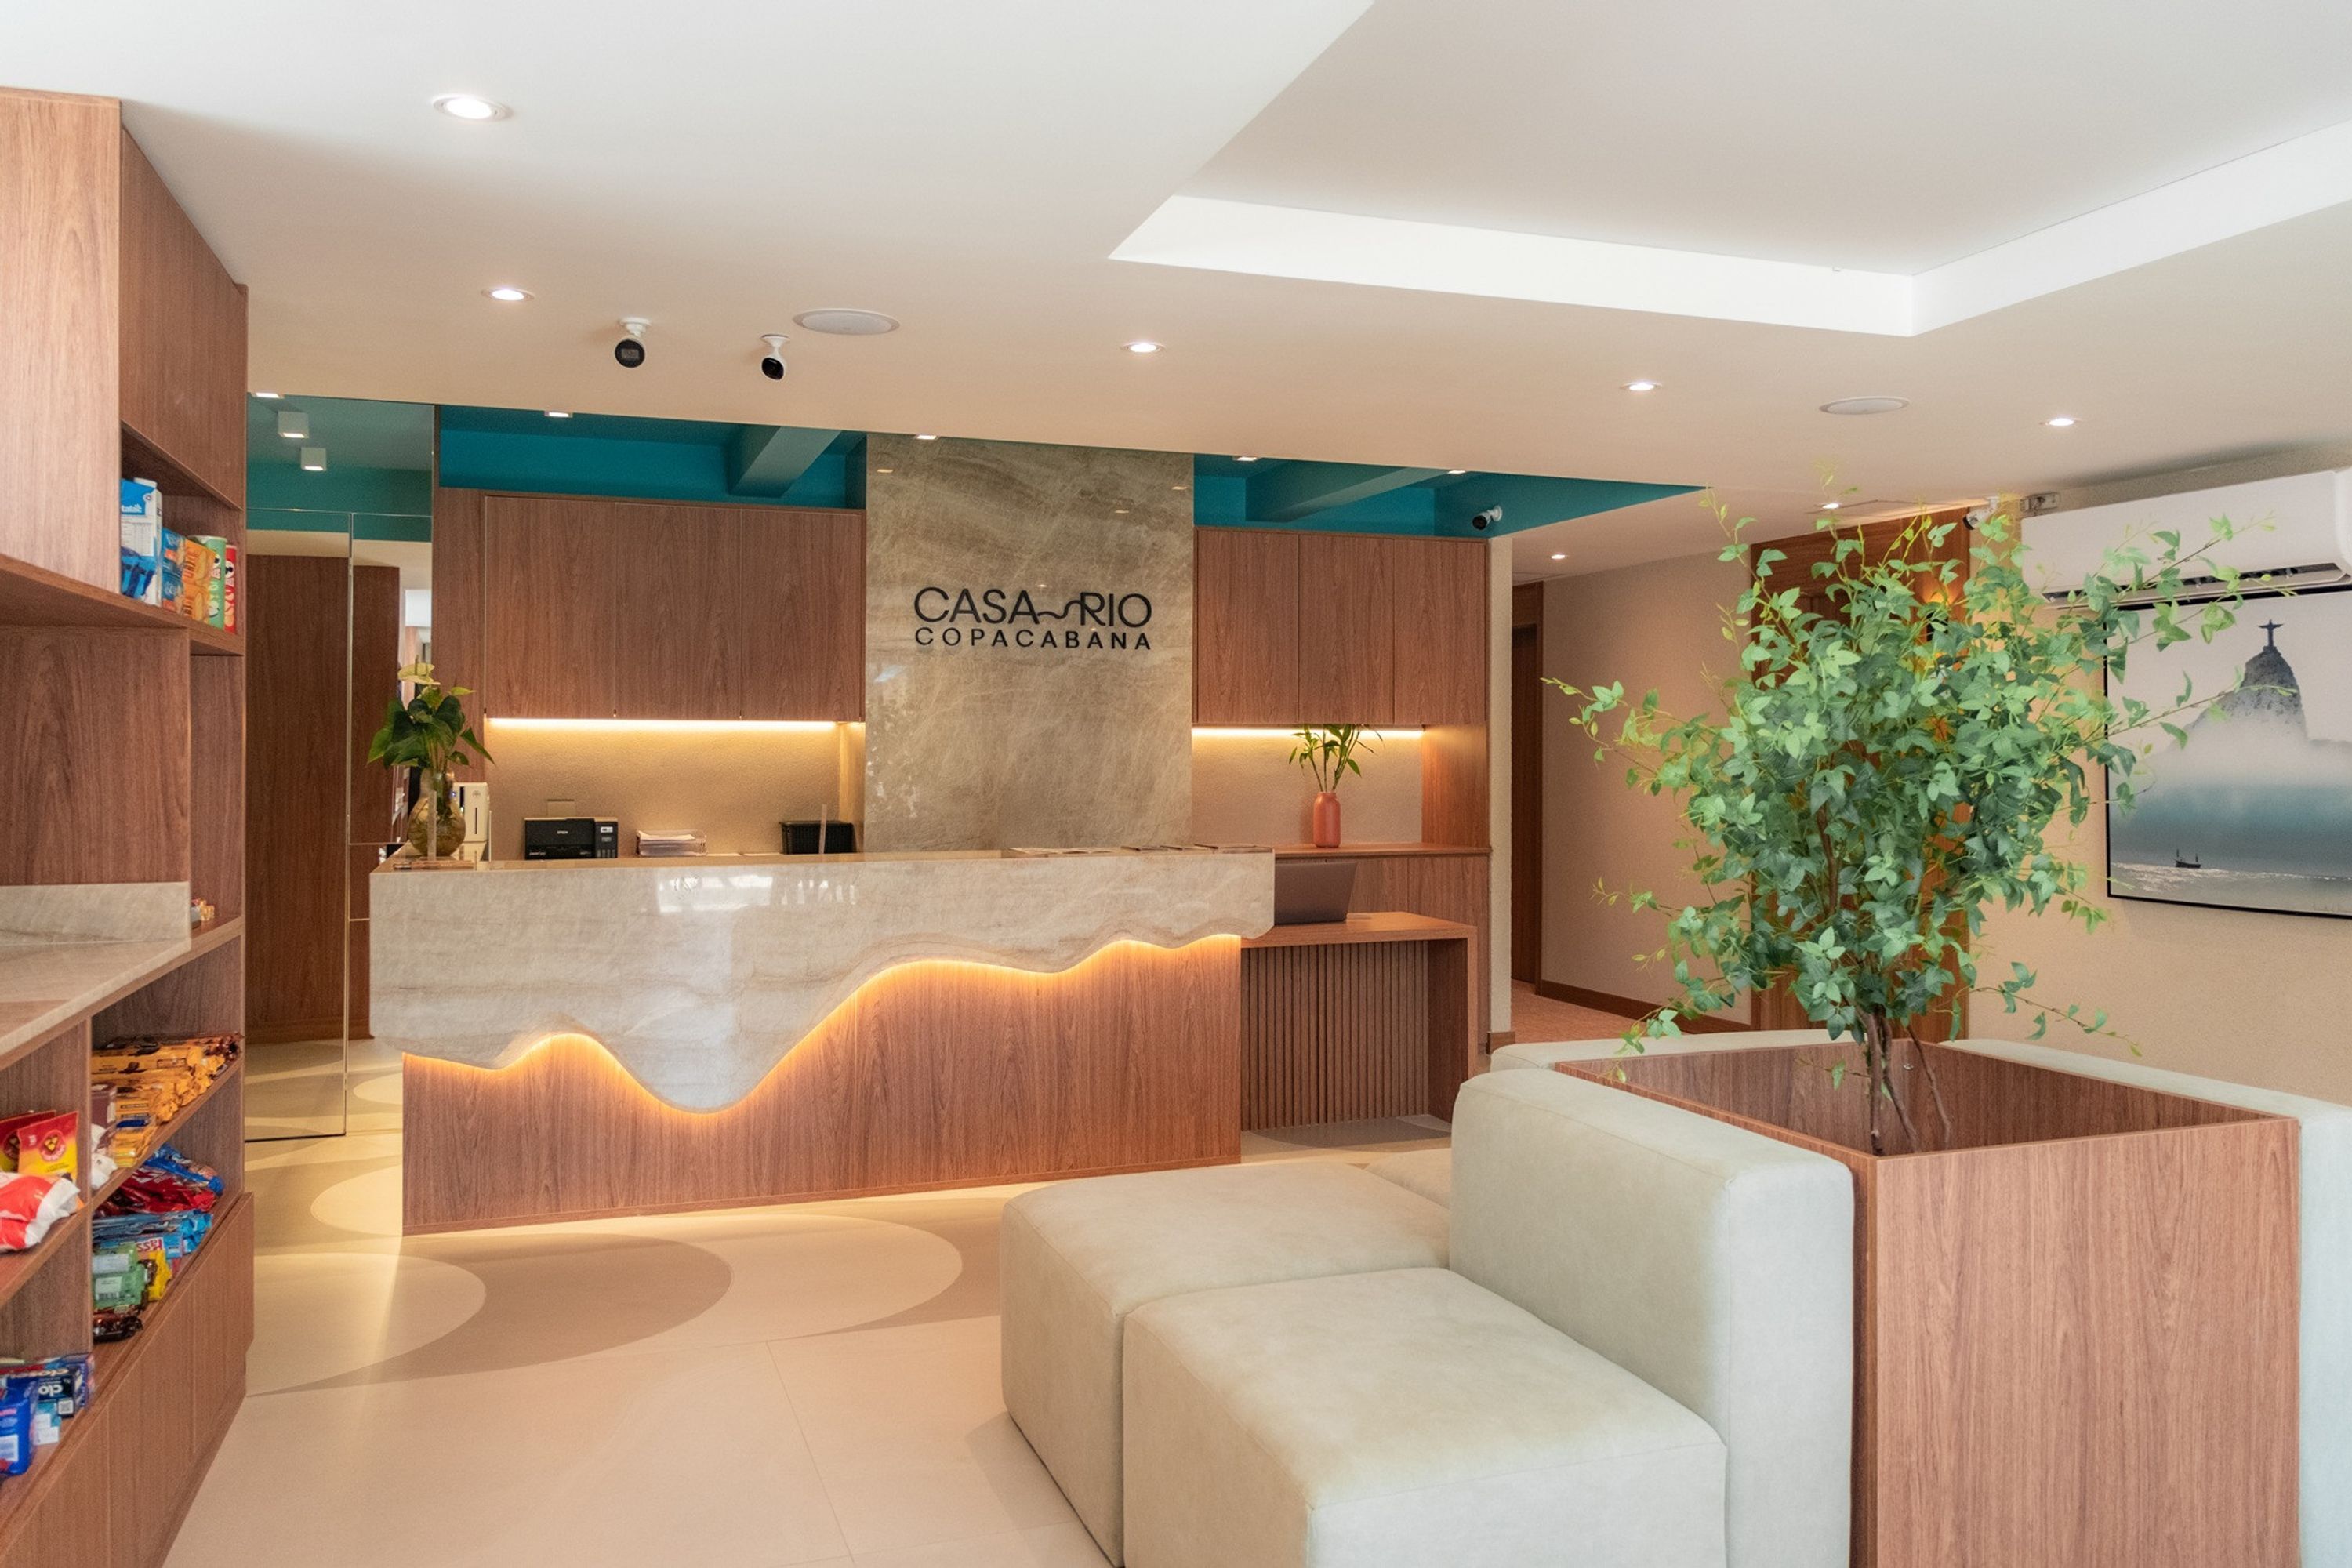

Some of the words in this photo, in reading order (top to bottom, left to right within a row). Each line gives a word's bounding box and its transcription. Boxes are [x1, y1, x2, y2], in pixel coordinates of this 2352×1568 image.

[914, 586, 1040, 625] CASA
[1080, 592, 1152, 627] RIO
[915, 627, 1151, 650] COPACABANA
